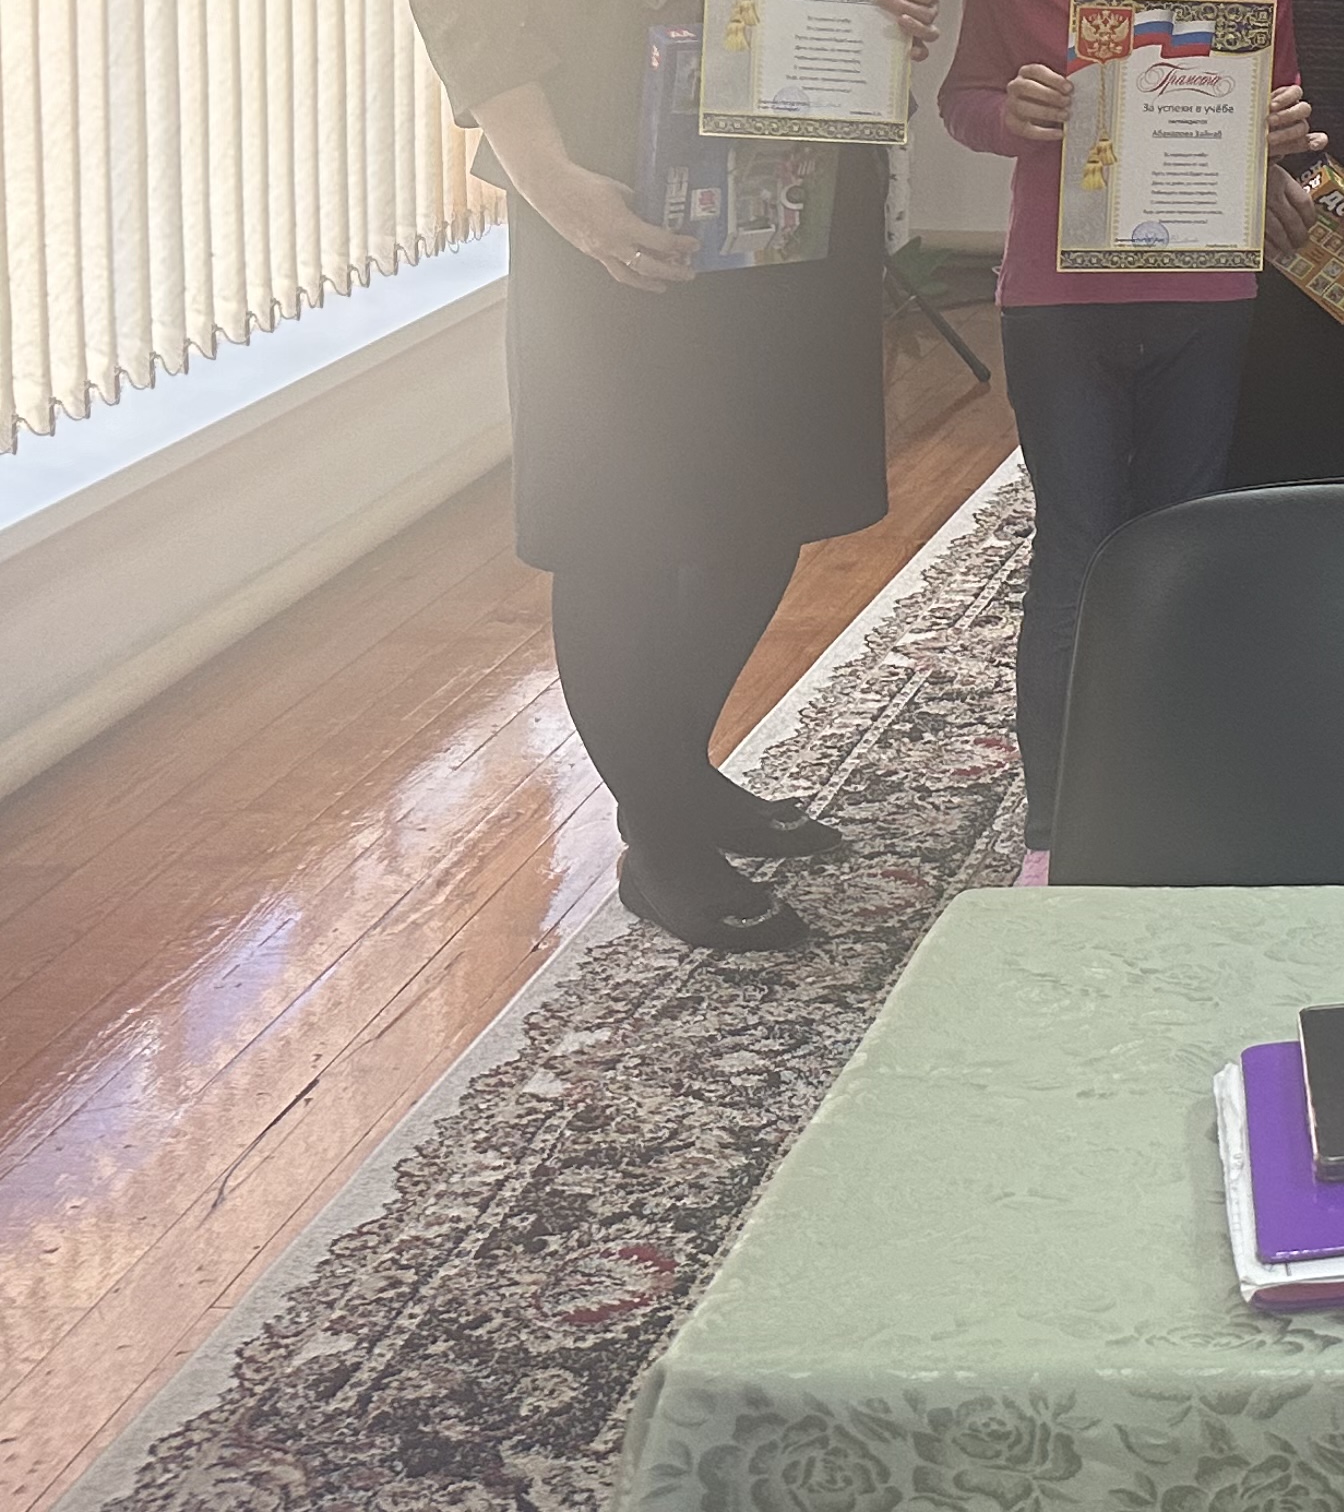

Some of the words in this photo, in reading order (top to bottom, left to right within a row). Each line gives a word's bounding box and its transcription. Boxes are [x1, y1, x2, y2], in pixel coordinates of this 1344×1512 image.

[1143, 103, 1155, 113] За
[1157, 104, 1193, 115] успехи
[1195, 105, 1202, 113] в
